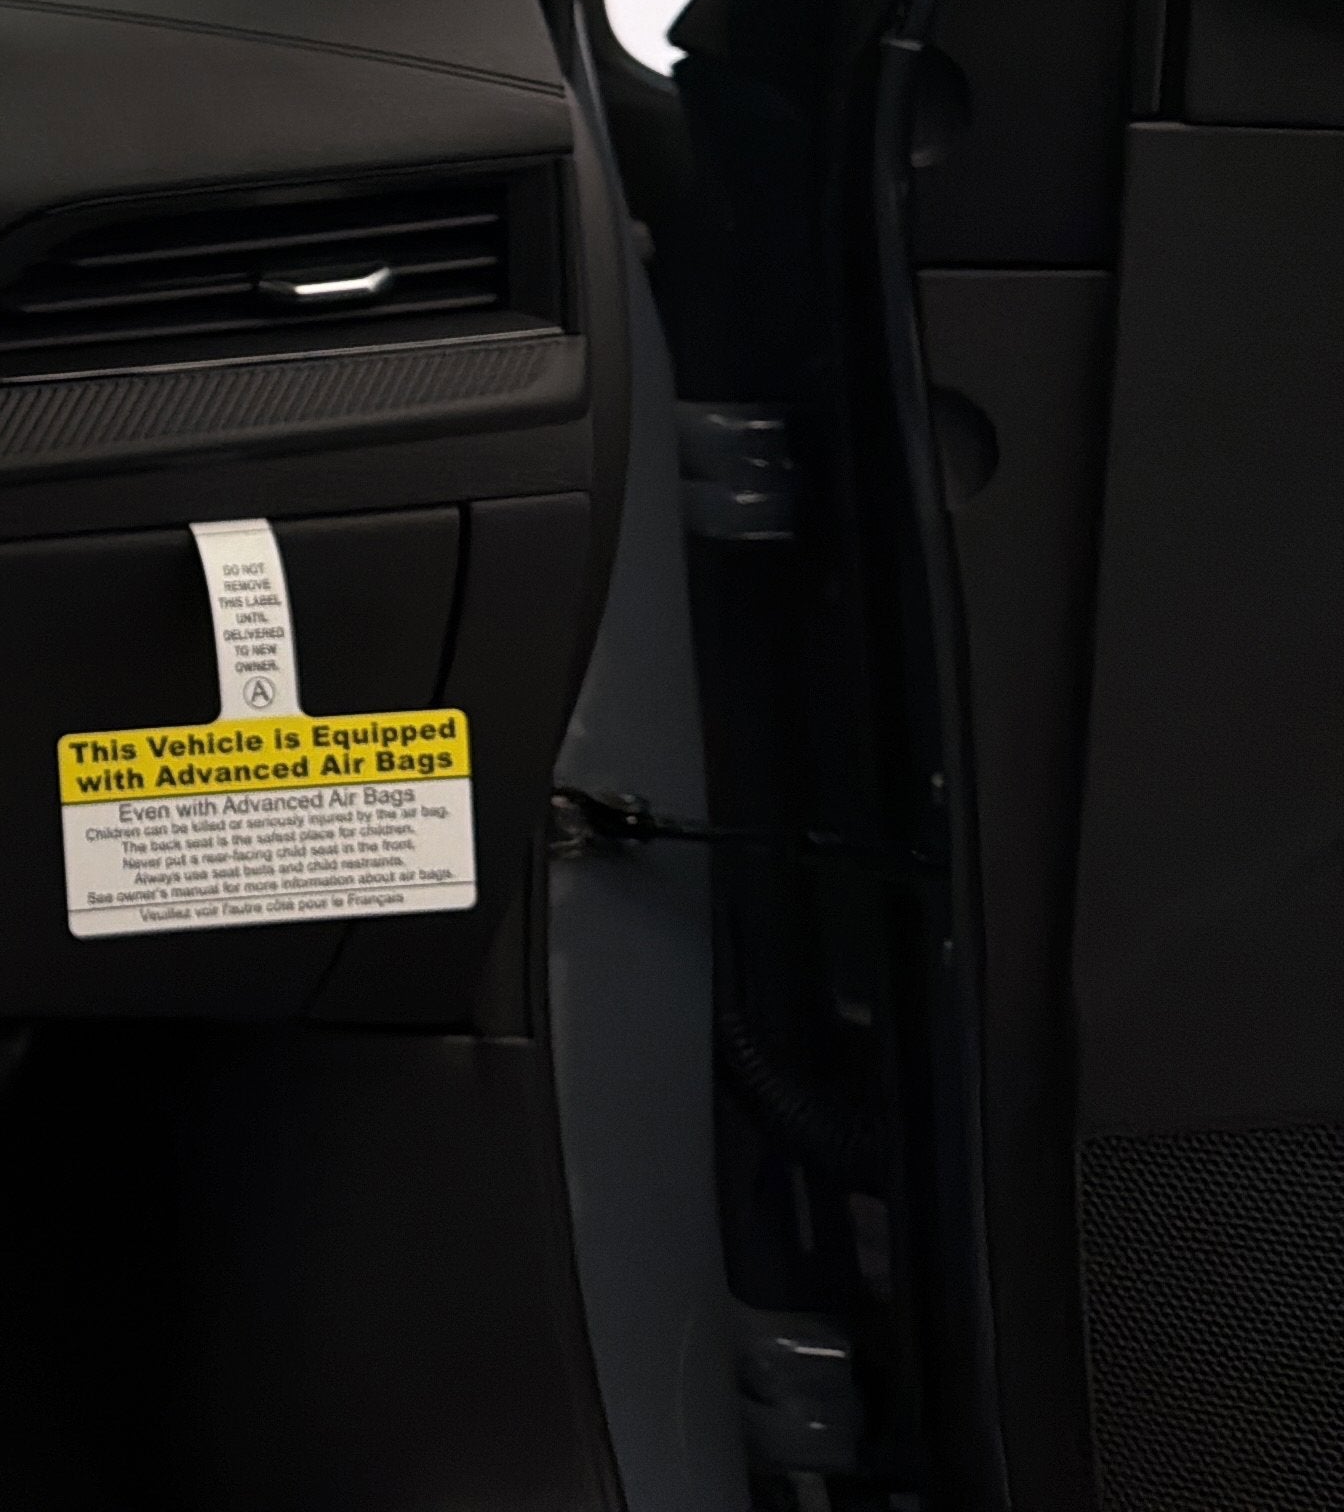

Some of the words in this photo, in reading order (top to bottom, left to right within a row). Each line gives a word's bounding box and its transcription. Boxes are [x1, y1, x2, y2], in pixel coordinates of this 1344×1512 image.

[223, 579, 272, 592] REMOVE
[245, 594, 282, 607] LABEL
[69, 739, 137, 764] This
[146, 730, 264, 758] Vehicle
[274, 727, 301, 749] is
[312, 716, 457, 750] Equipped
[76, 767, 145, 794] with
[155, 754, 309, 789] Advanced
[320, 752, 366, 776] Air
[375, 750, 454, 776] Bags
[118, 802, 171, 824] Even
[176, 798, 218, 819] with
[223, 790, 324, 816] Advanced
[329, 788, 358, 808] Air
[363, 787, 416, 808] Bags
[85, 827, 142, 843] Children
[143, 825, 169, 838] can
[171, 822, 189, 835] be
[191, 819, 226, 834] killed
[228, 819, 243, 830] or
[246, 814, 304, 831] seriously
[308, 811, 354, 826] injured
[356, 809, 372, 823] by
[376, 808, 398, 820] the
[400, 807, 417, 819] air
[121, 840, 148, 855] The
[150, 839, 182, 852] back
[184, 837, 214, 850] seat
[216, 835, 229, 848] is
[231, 834, 253, 846] the
[255, 829, 296, 845] safest
[298, 828, 335, 843] place
[339, 826, 356, 839] for
[122, 855, 162, 870] Never
[164, 853, 187, 869] put
[189, 854, 200, 866] a
[201, 848, 274, 865] rear-facing
[276, 845, 307, 859] child
[310, 843, 339, 857] seat
[341, 842, 355, 854] in
[357, 840, 379, 853] the
[133, 870, 181, 886] Always
[183, 869, 209, 881] use
[212, 866, 241, 880] seat
[243, 862, 275, 876] belts
[278, 860, 304, 874] and
[307, 857, 338, 872] child
[86, 891, 114, 906] See
[116, 887, 169, 902] owner's
[171, 883, 220, 898] manual
[223, 881, 240, 893] for
[244, 879, 279, 892] more
[281, 873, 355, 890] information
[358, 871, 396, 885] about
[399, 870, 417, 882] air
[194, 905, 219, 918] voir
[298, 898, 328, 913] pour
